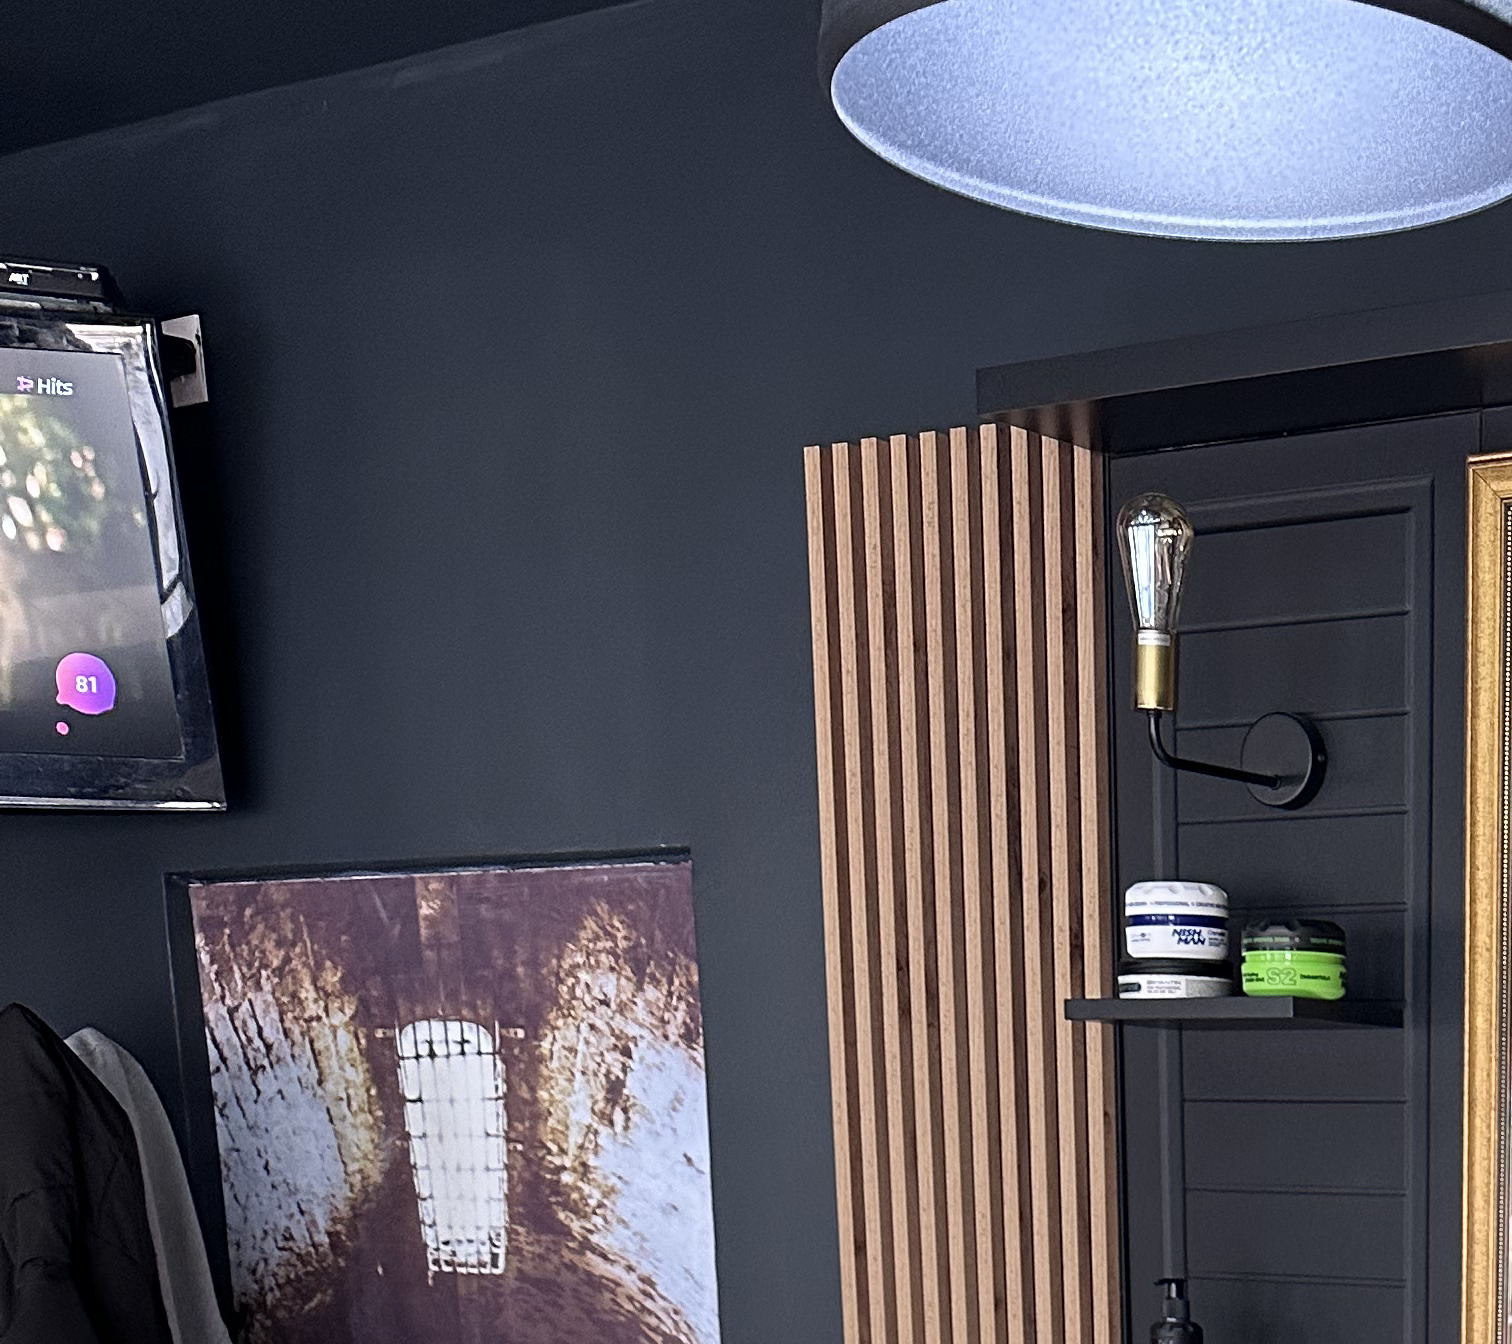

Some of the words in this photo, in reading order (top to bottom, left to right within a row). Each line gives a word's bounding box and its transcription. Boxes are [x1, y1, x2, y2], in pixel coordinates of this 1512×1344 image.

[37, 377, 73, 395] Hits
[75, 675, 97, 693] 81
[1266, 967, 1297, 986] S2
